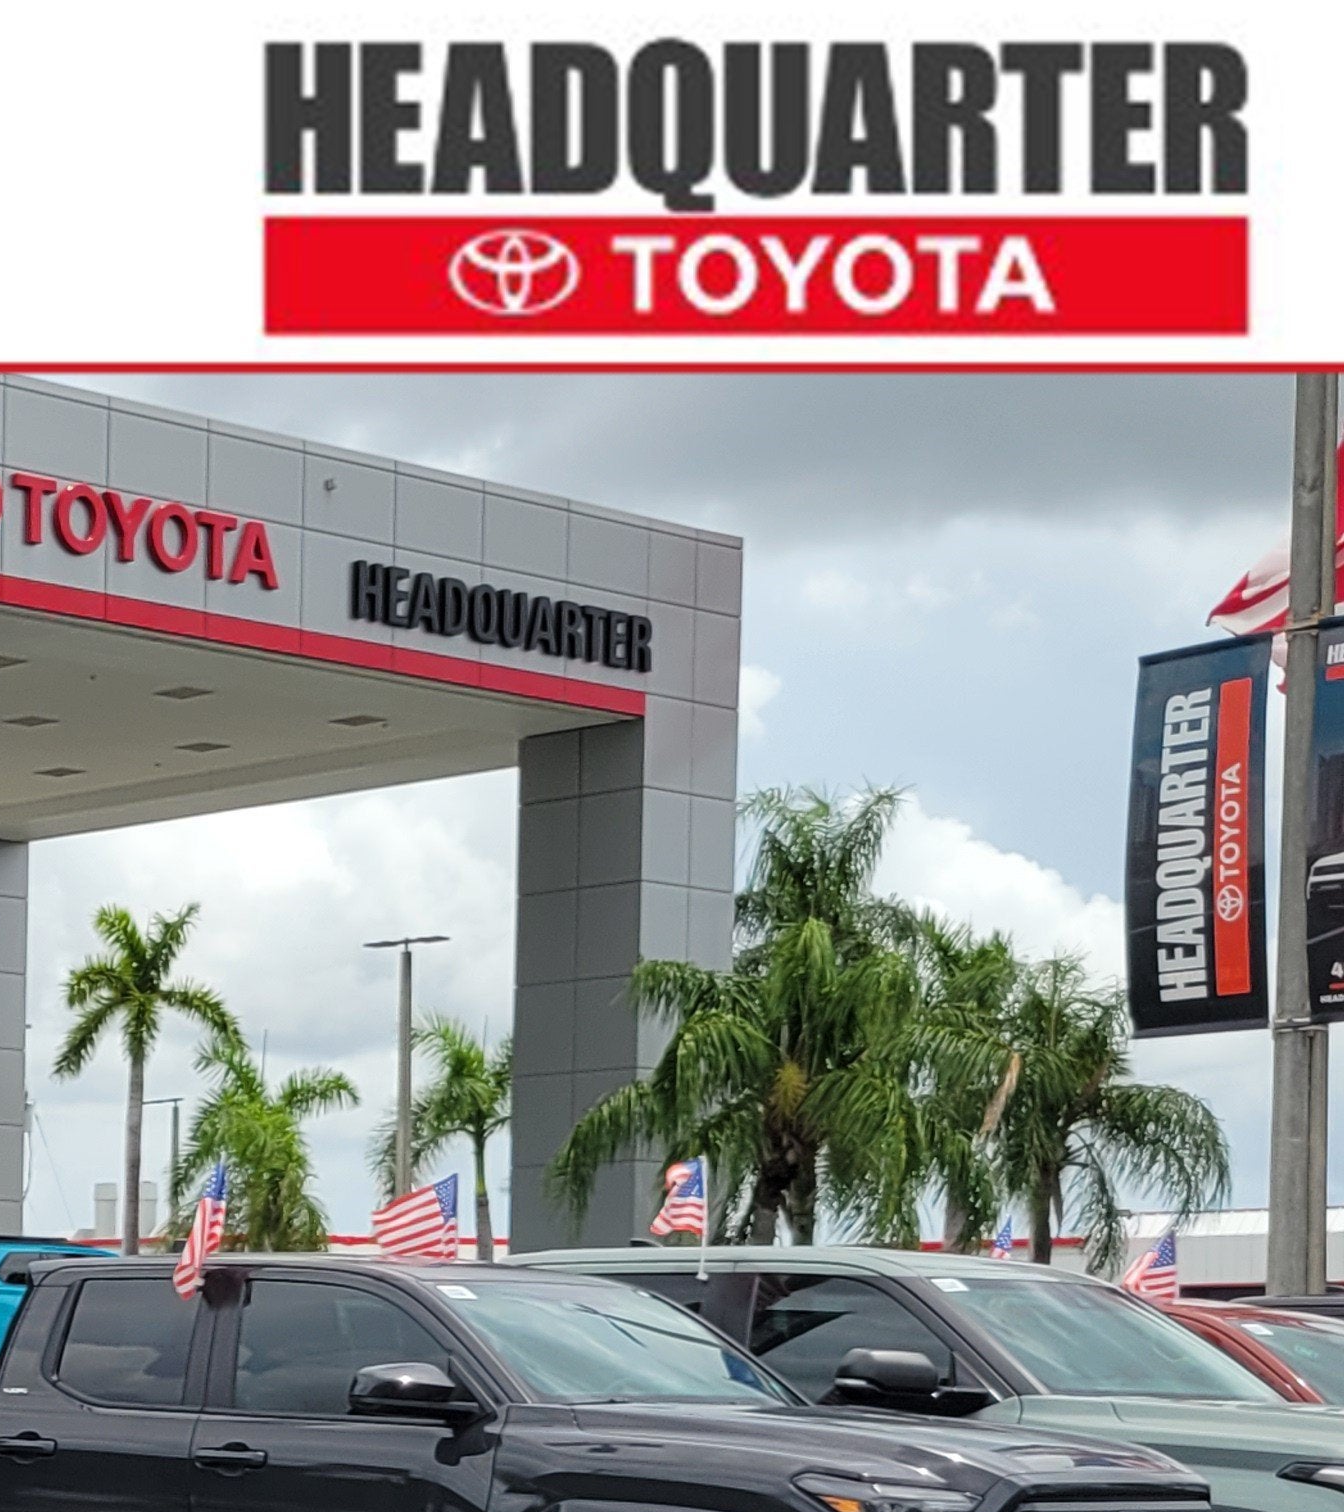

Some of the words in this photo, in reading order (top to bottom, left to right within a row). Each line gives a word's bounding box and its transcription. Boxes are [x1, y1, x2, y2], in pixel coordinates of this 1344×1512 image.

[12, 472, 280, 590] TOYOTA
[350, 559, 653, 673] HEADQUARTER
[1155, 686, 1213, 1002] HEADQUARTER
[1219, 762, 1242, 883] TOYOTA
